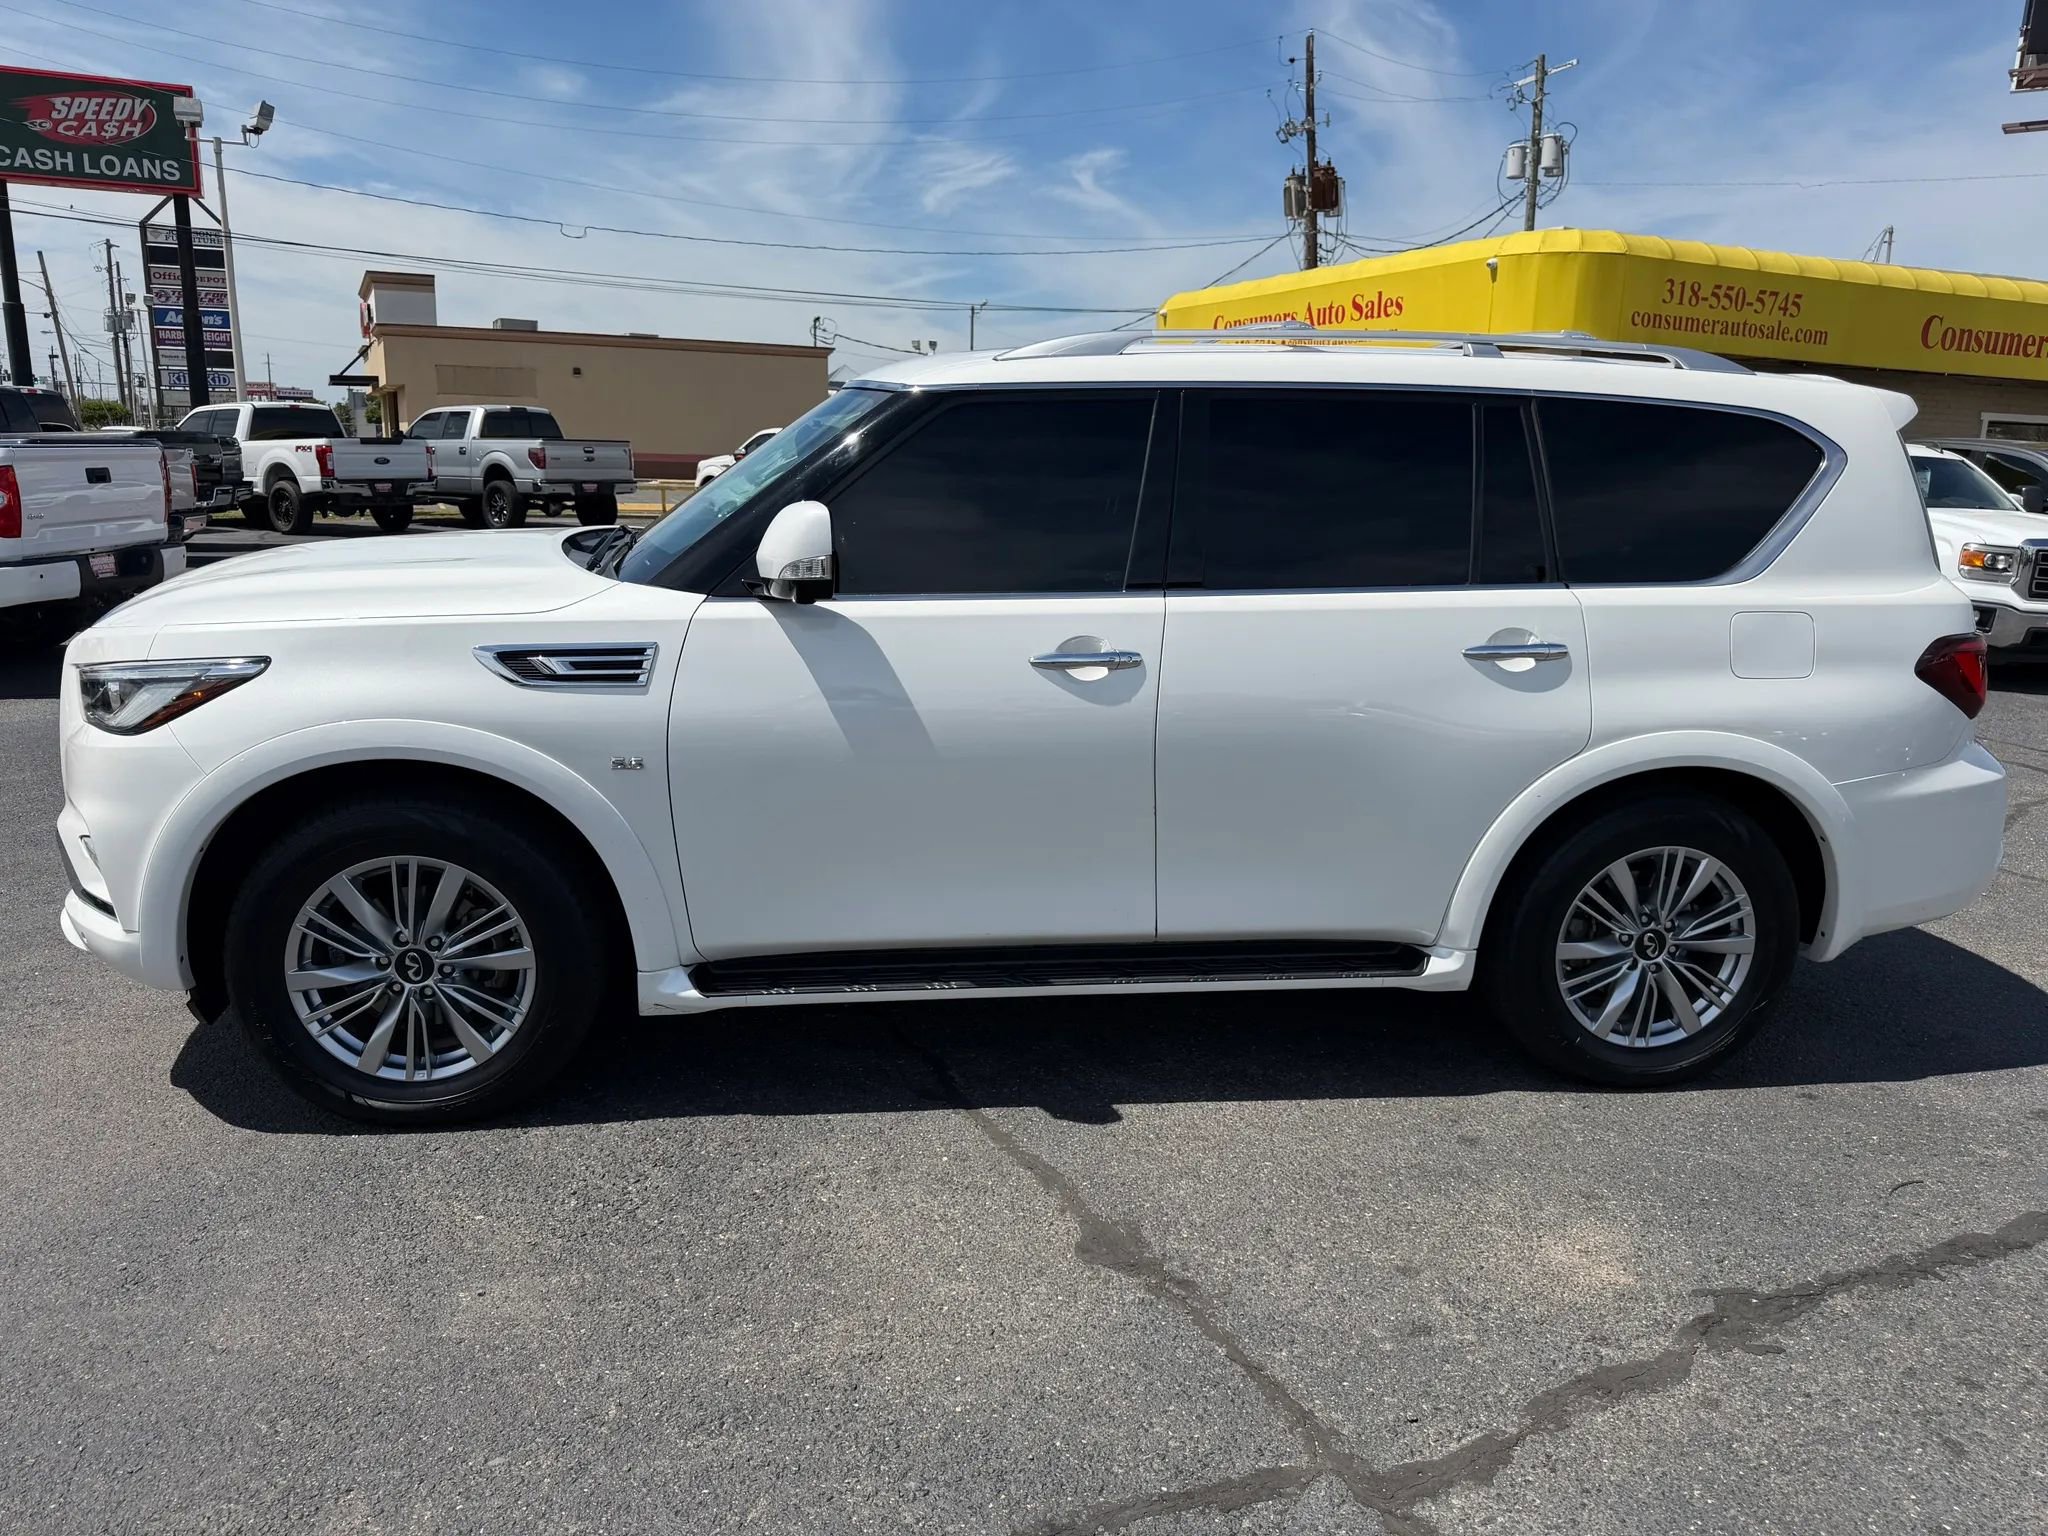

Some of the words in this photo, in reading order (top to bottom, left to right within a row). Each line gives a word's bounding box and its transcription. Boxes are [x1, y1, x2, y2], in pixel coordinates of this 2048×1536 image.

[48, 96, 150, 121] SPEEDY
[0, 145, 74, 173] CASH
[82, 152, 181, 181] LOANS
[165, 234, 223, 244] FUITURE
[153, 272, 182, 281] Offic
[1304, 301, 1346, 327] Auto
[1351, 291, 1404, 322] Sales
[1662, 278, 1803, 318] 318-550-5745
[164, 310, 223, 325] Aan's
[1631, 310, 1829, 346] consumerautosale.com
[159, 330, 185, 341] HARB
[203, 331, 231, 342] REIGHT
[1921, 314, 2048, 358] Consumer
